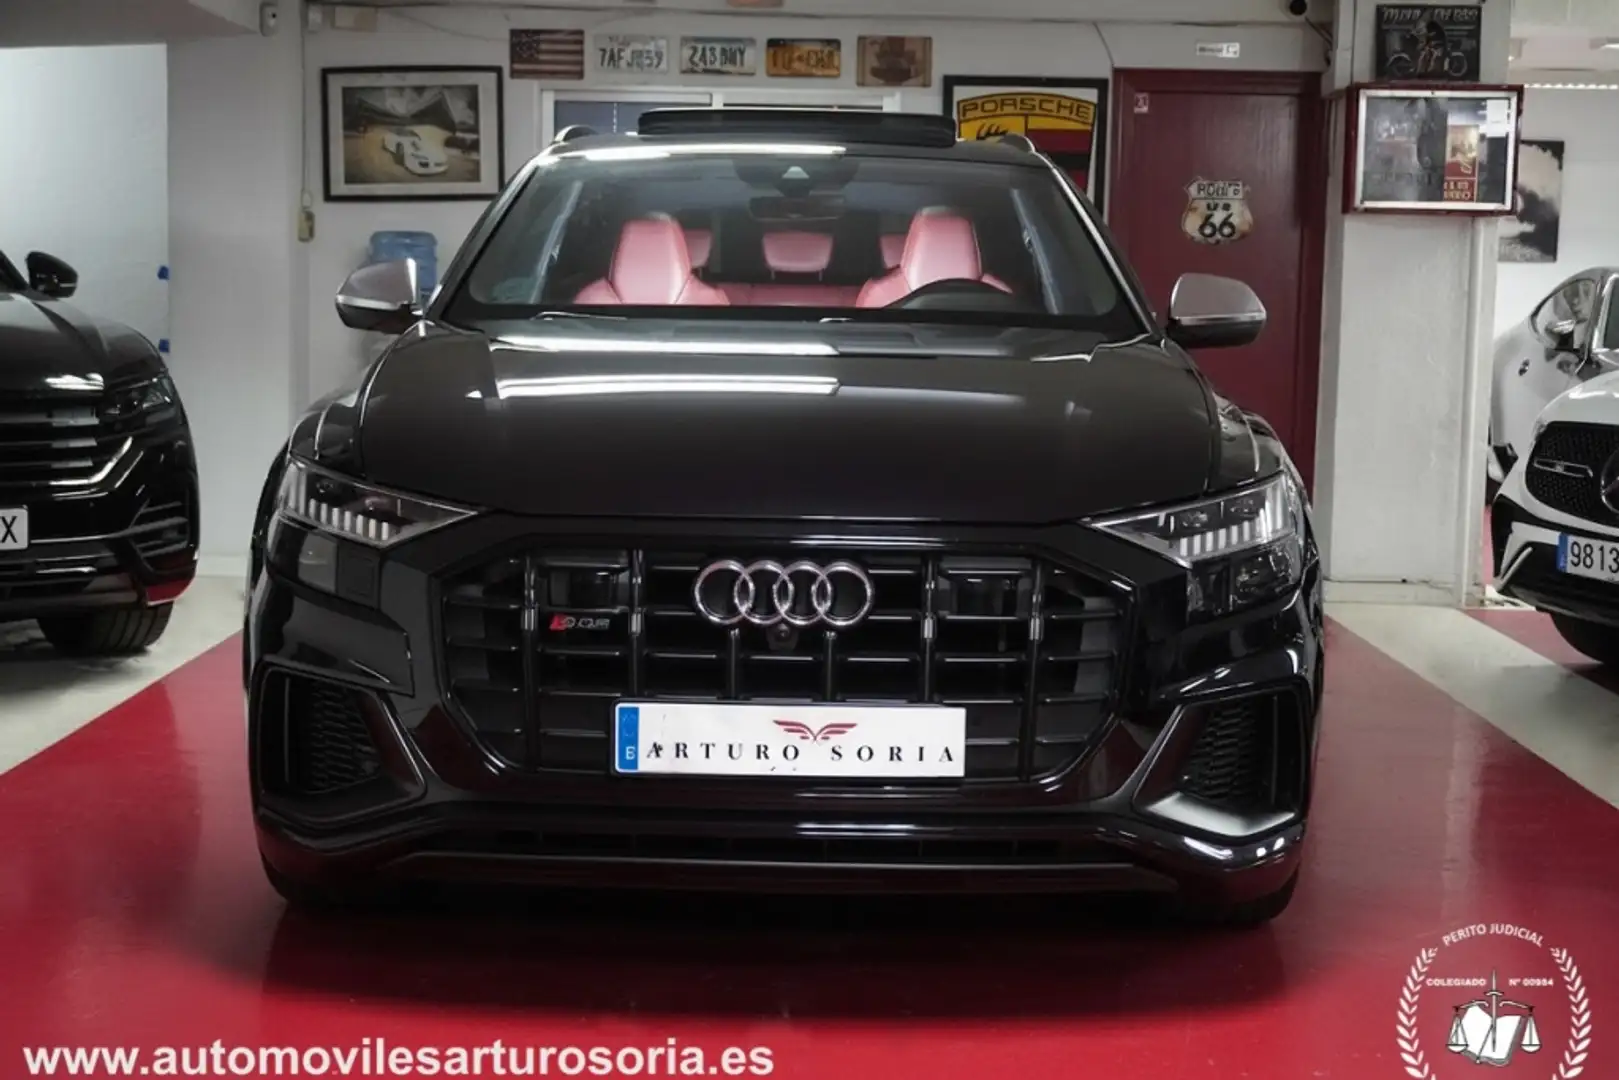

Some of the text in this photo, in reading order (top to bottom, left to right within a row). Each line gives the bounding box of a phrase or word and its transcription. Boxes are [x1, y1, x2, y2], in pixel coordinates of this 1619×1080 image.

[961, 98, 1091, 119] PORSCHE
[1198, 212, 1236, 238] 66
[1570, 541, 1619, 574] 9813
[647, 742, 954, 763] ARTURO SORIA
